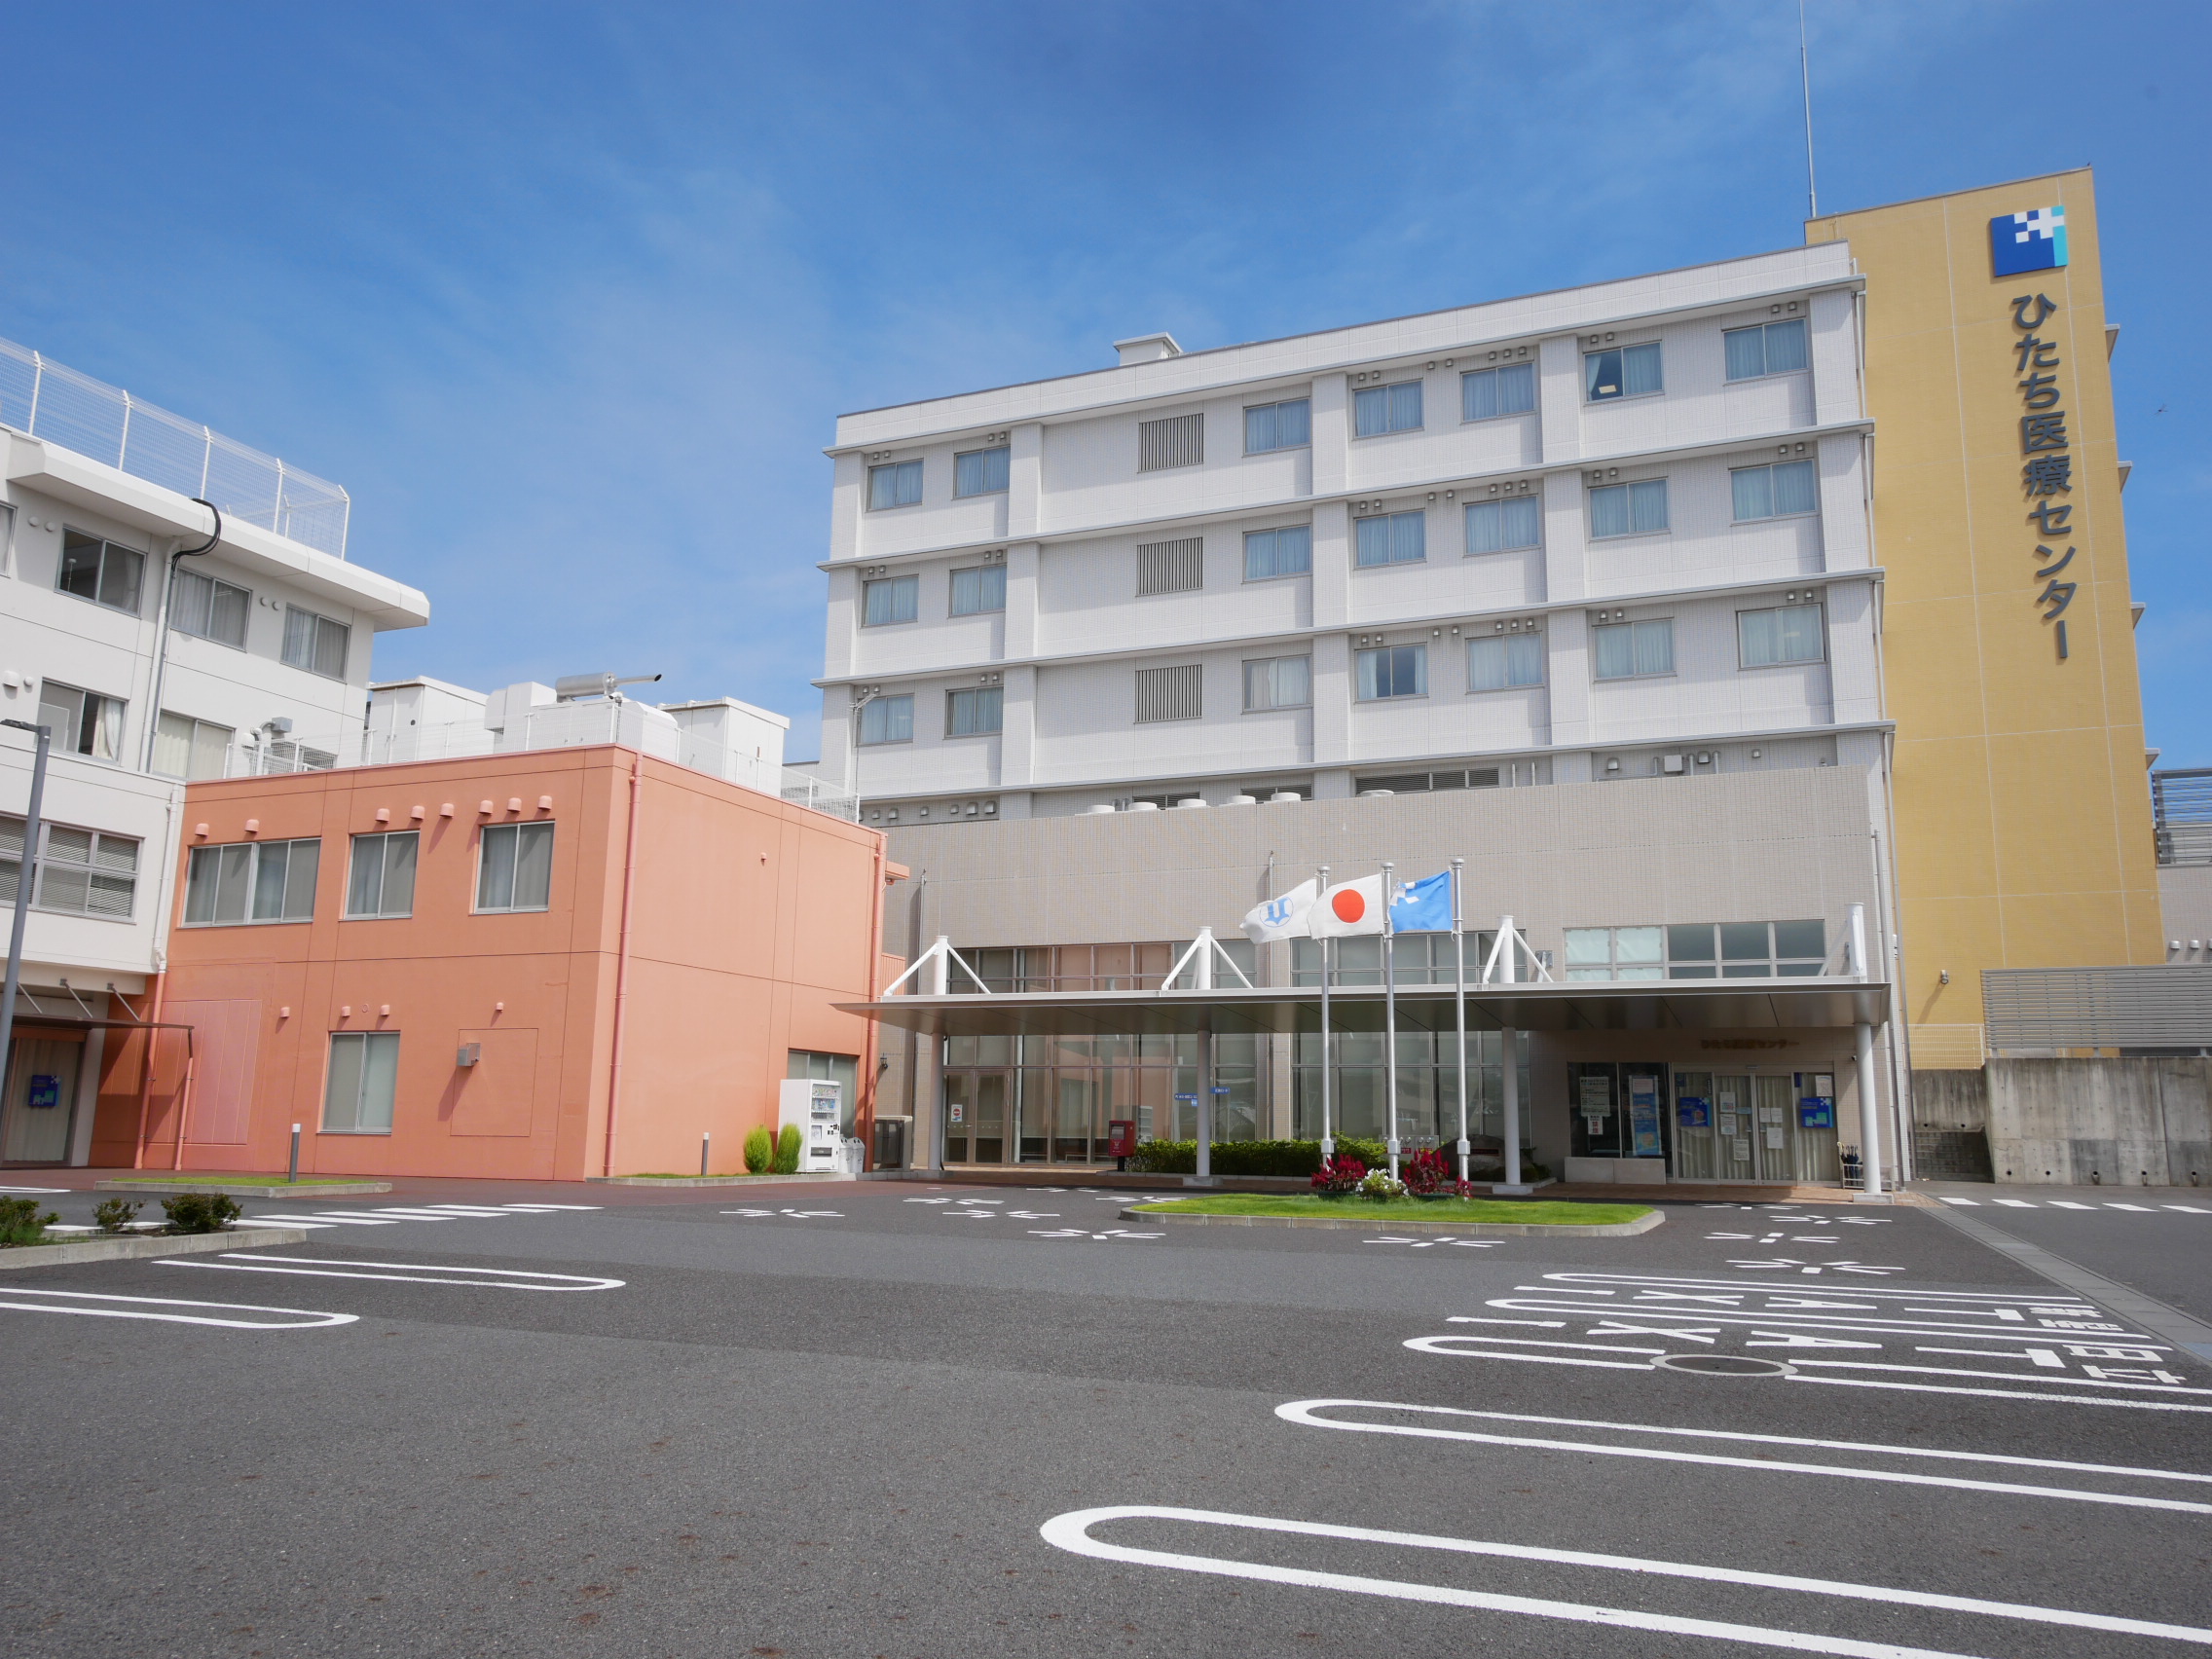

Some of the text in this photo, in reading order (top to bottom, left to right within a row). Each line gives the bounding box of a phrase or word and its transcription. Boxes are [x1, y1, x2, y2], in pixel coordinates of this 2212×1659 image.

[2011, 293, 2077, 659] ひたち医療センター
[1514, 1285, 2025, 1321] TAXI
[1446, 1316, 2067, 1369] TAXI
[2062, 1345, 2187, 1384] 日立
